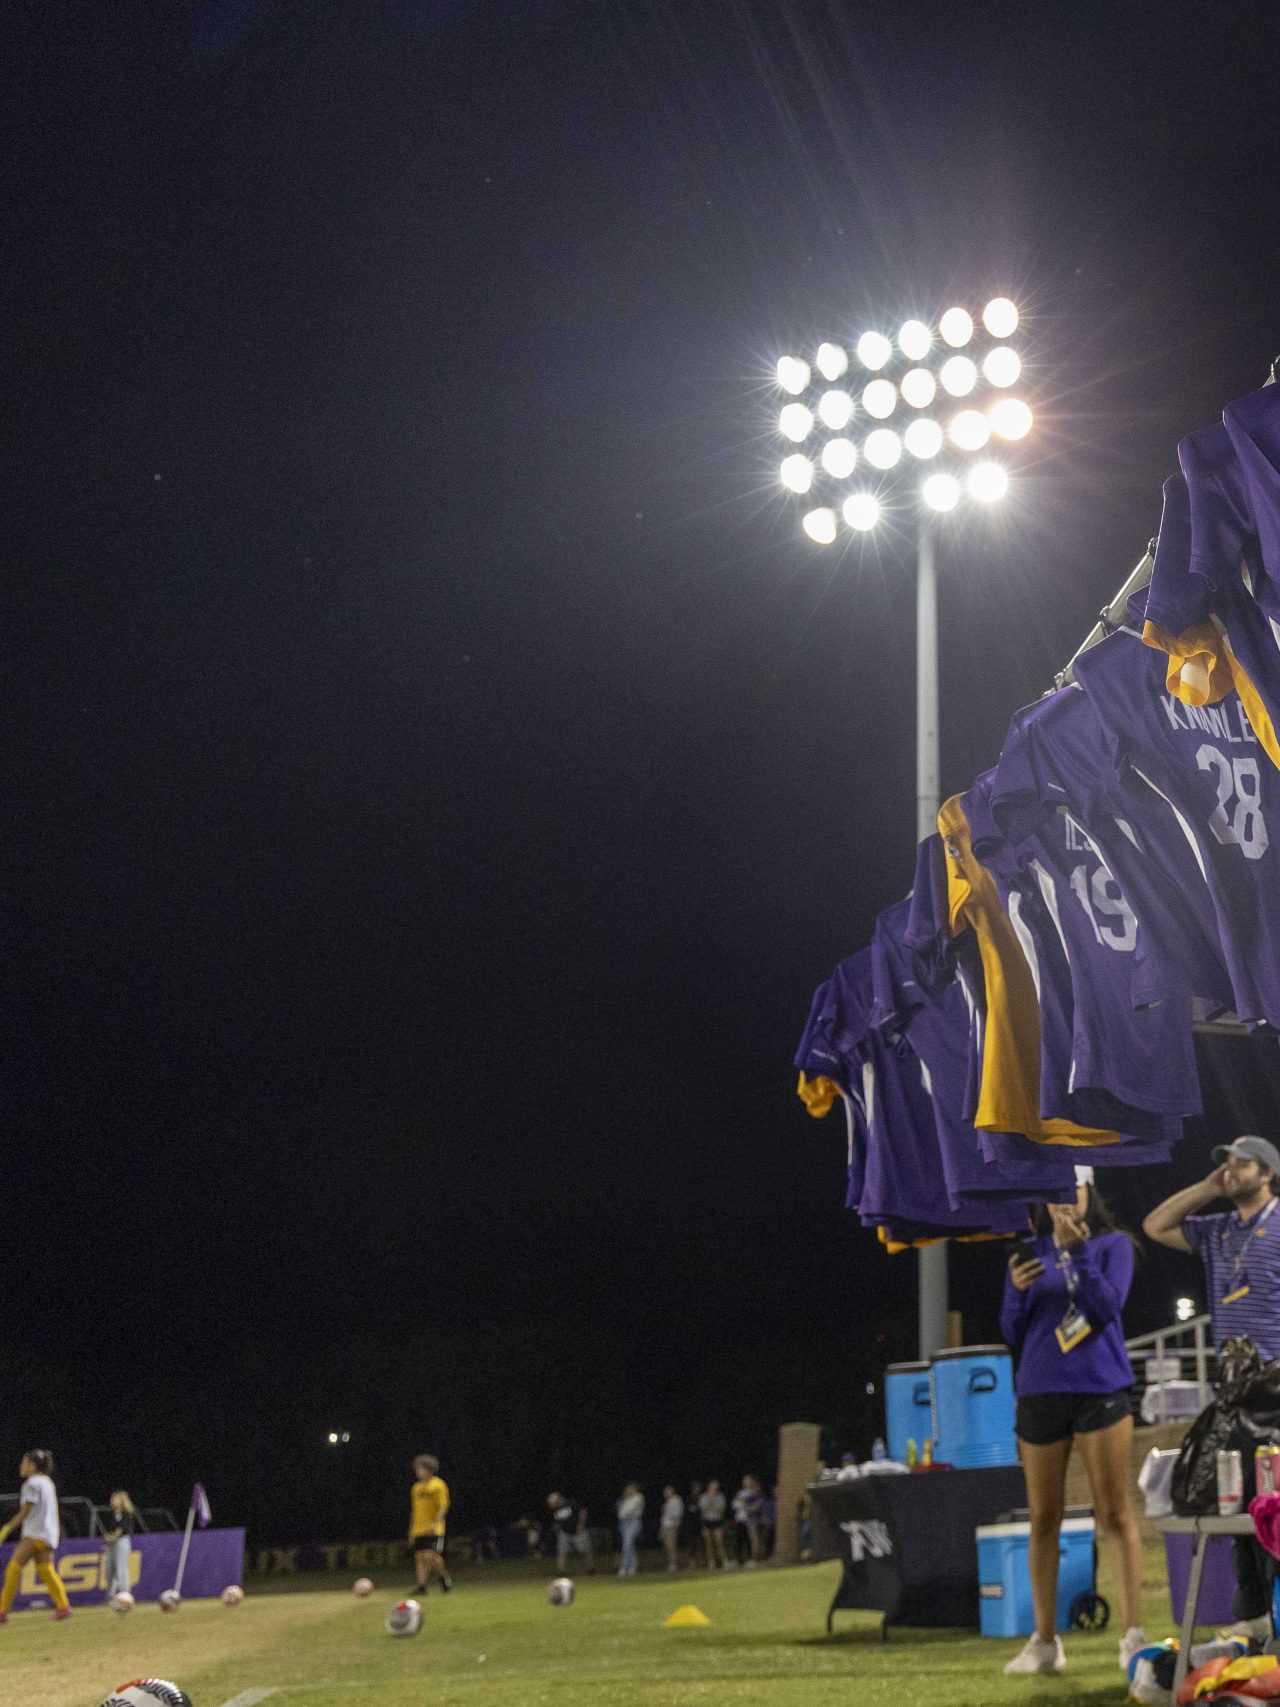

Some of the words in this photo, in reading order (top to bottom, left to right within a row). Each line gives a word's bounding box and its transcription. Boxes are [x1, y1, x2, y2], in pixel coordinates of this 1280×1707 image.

[1195, 744, 1269, 860] 28
[1070, 864, 1137, 952] 19
[19, 1550, 142, 1596] LSU
